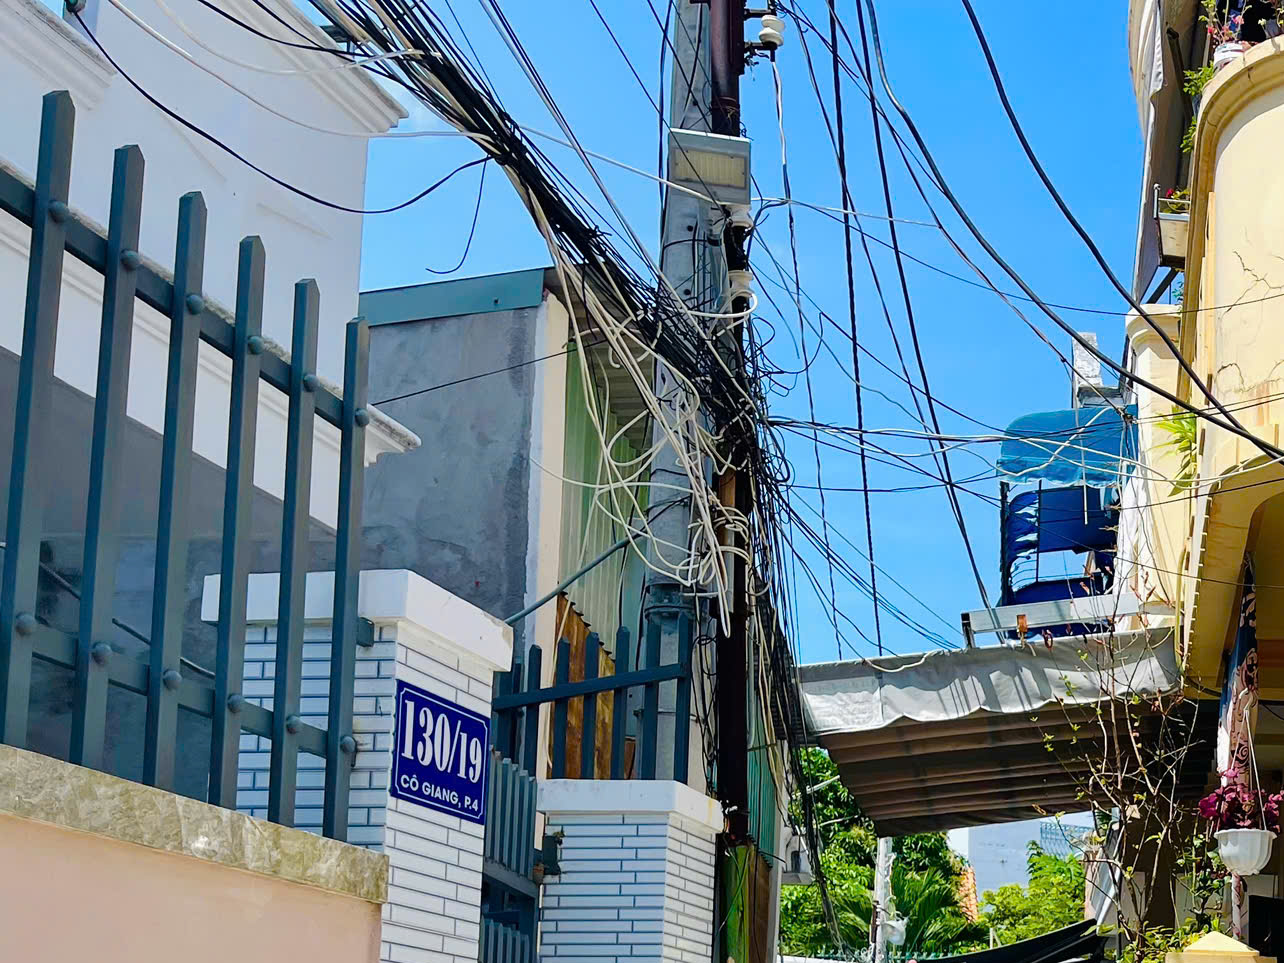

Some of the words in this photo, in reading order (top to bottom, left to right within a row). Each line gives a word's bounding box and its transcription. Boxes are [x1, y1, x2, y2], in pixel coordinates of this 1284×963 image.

[401, 700, 482, 784] 130/19
[400, 774, 419, 791] CÔ
[422, 781, 462, 809] GIANG,
[464, 795, 479, 812] P.4
